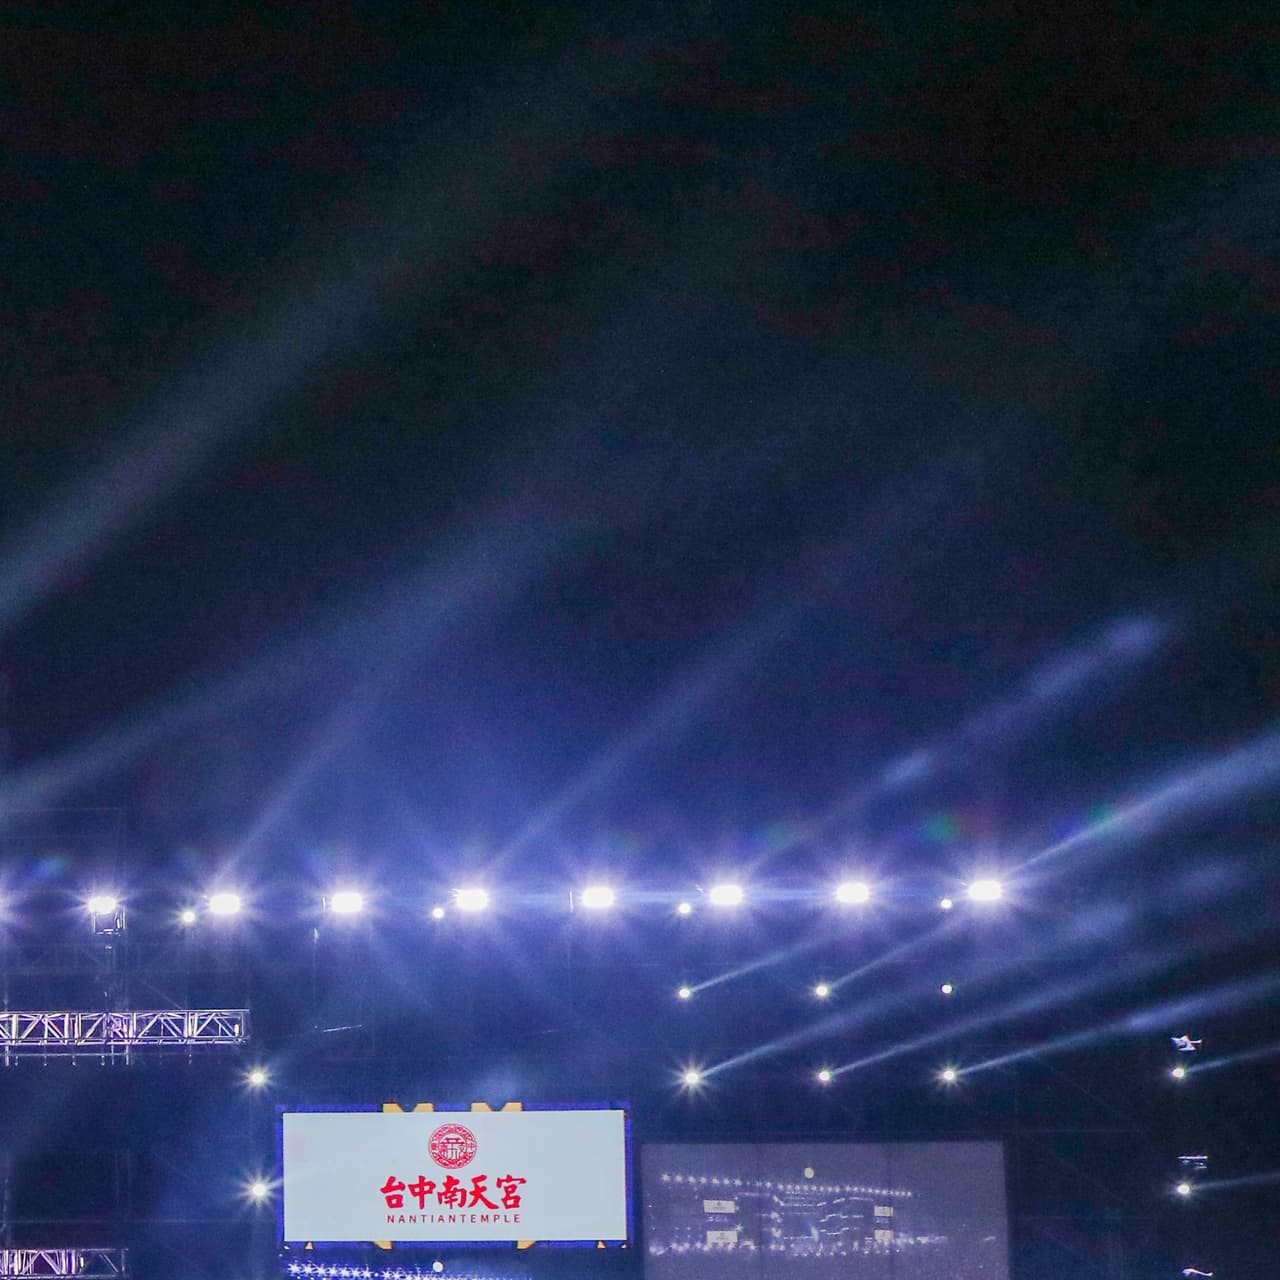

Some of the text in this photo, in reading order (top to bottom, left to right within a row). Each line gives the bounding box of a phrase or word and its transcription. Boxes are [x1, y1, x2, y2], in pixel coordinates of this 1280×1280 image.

[380, 1174, 527, 1210] 台中南天宮
[387, 1213, 521, 1224] NANTIANTEMPLE
